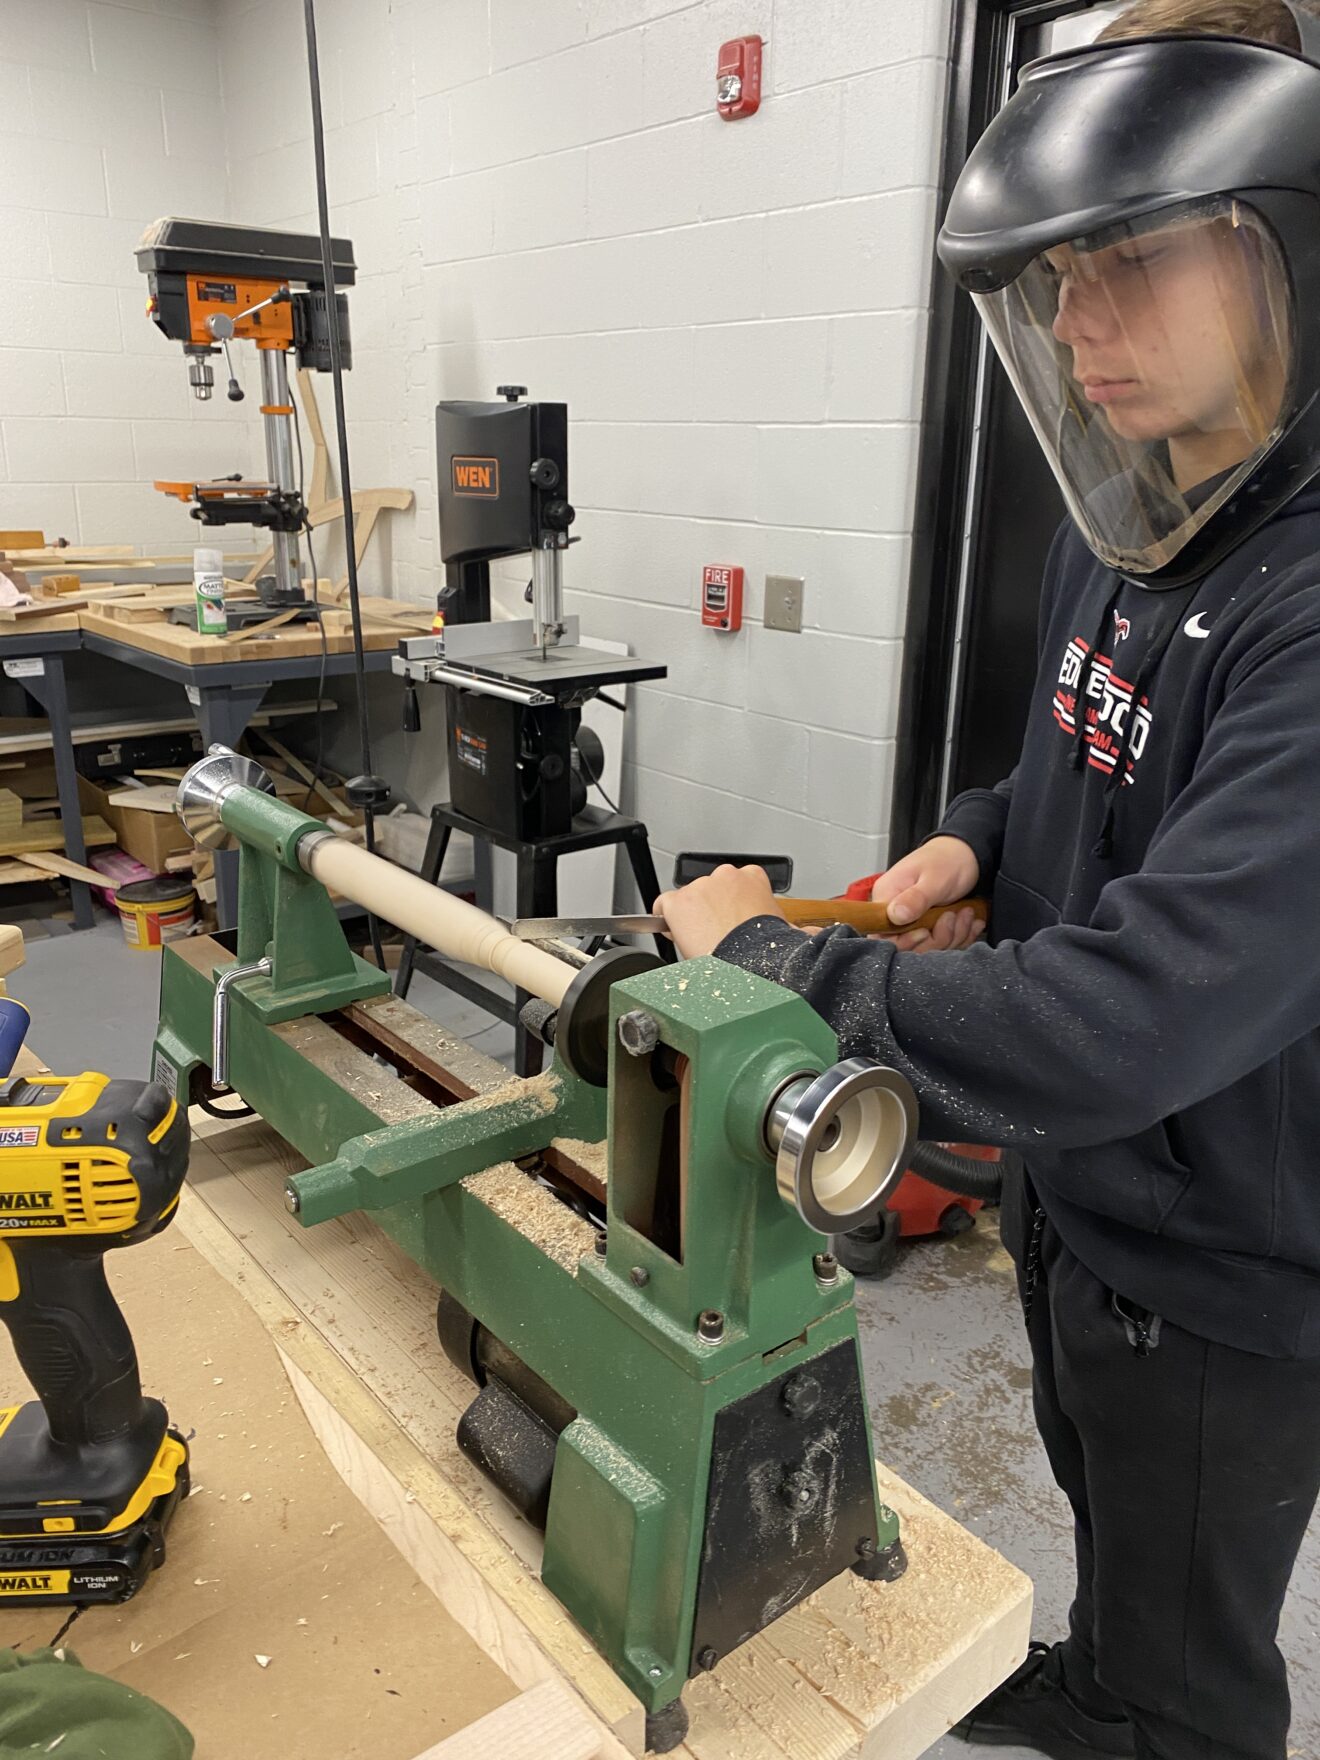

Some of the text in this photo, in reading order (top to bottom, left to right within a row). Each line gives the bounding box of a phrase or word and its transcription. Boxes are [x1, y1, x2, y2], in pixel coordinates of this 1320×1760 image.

[455, 465, 490, 488] WEN
[705, 568, 729, 583] FIRE
[0, 1131, 24, 1143] USA
[73, 1575, 119, 1584] LITHIUM
